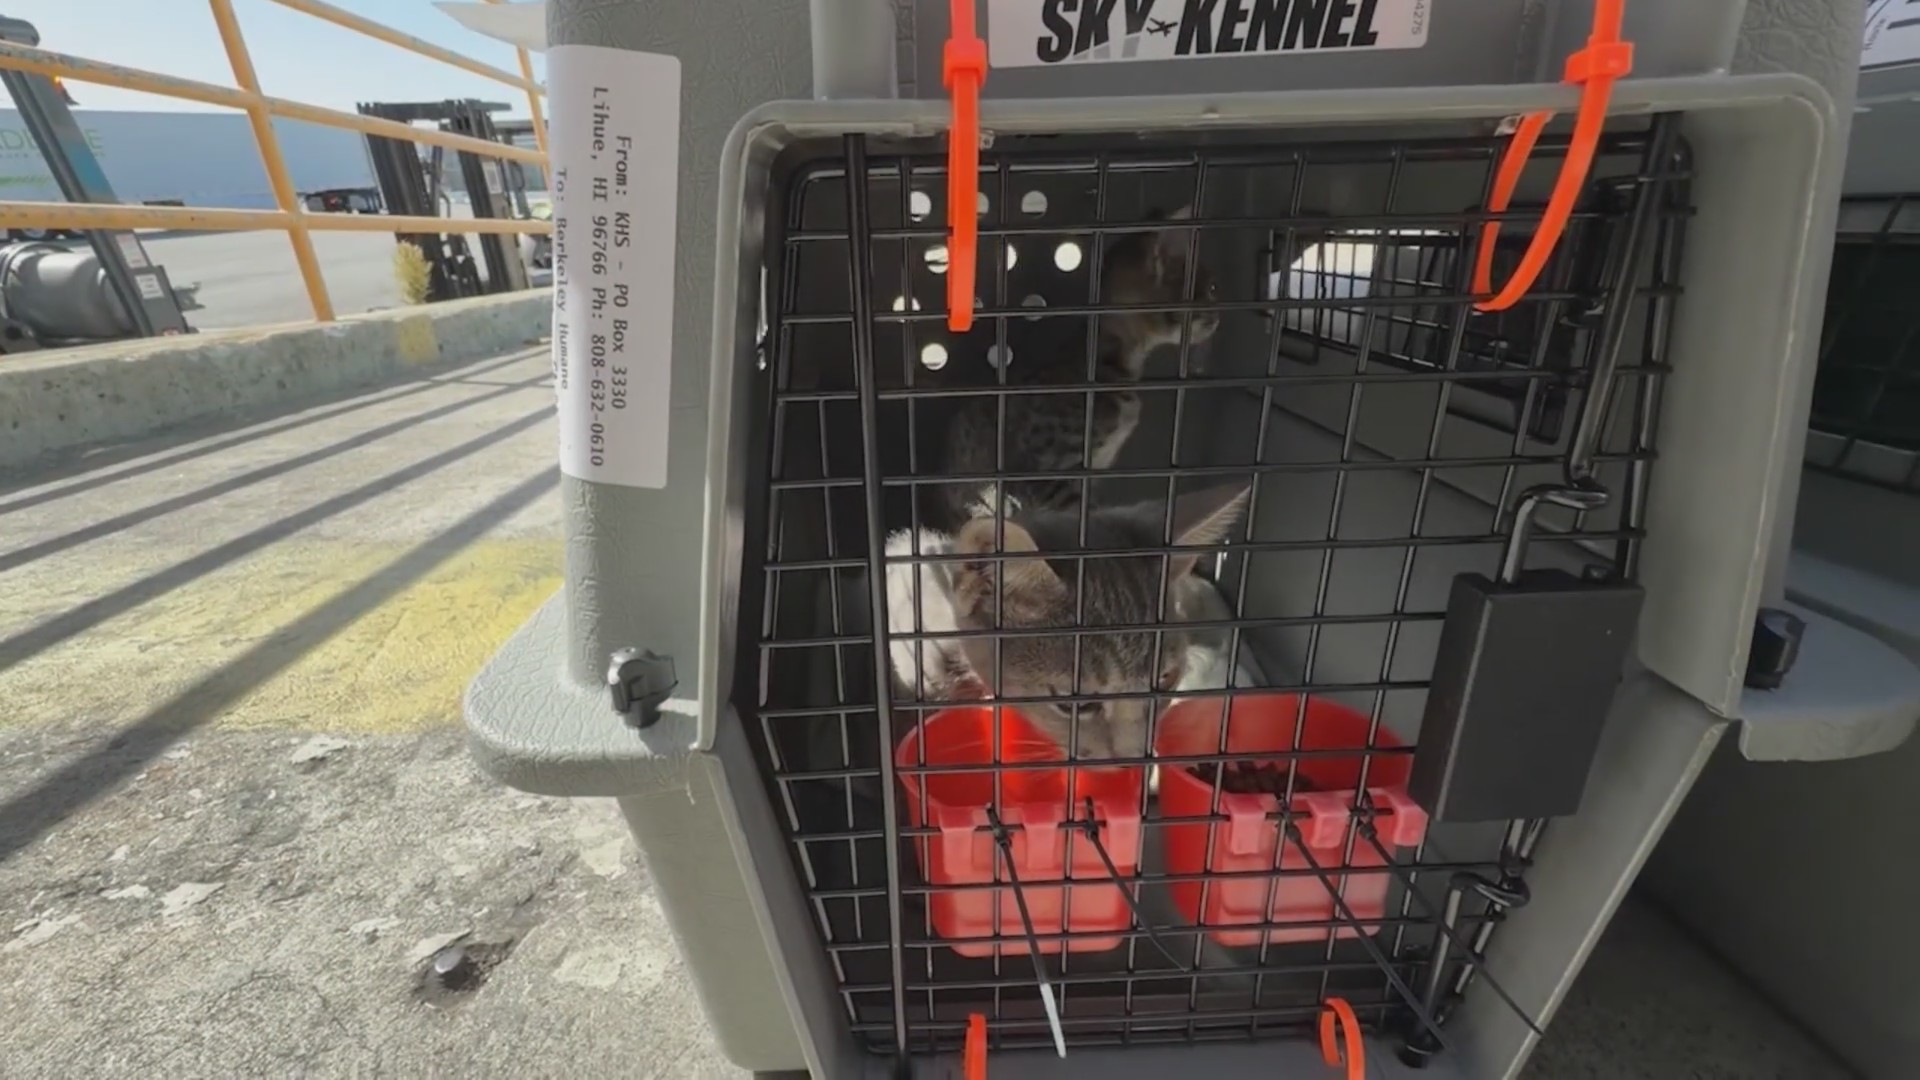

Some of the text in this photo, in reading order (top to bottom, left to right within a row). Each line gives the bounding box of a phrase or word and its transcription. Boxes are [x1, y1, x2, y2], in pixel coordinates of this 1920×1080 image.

[1037, 0, 1379, 63] SKY KENNEL
[615, 135, 632, 196] From:
[614, 211, 630, 248] KHS
[556, 168, 570, 390] To: Berkeley Humane
[590, 86, 610, 467] Lihue, HI 96766 Ph: 808-632-0610
[613, 283, 629, 308] PO
[612, 319, 628, 353] Box
[611, 366, 628, 410] 3330
